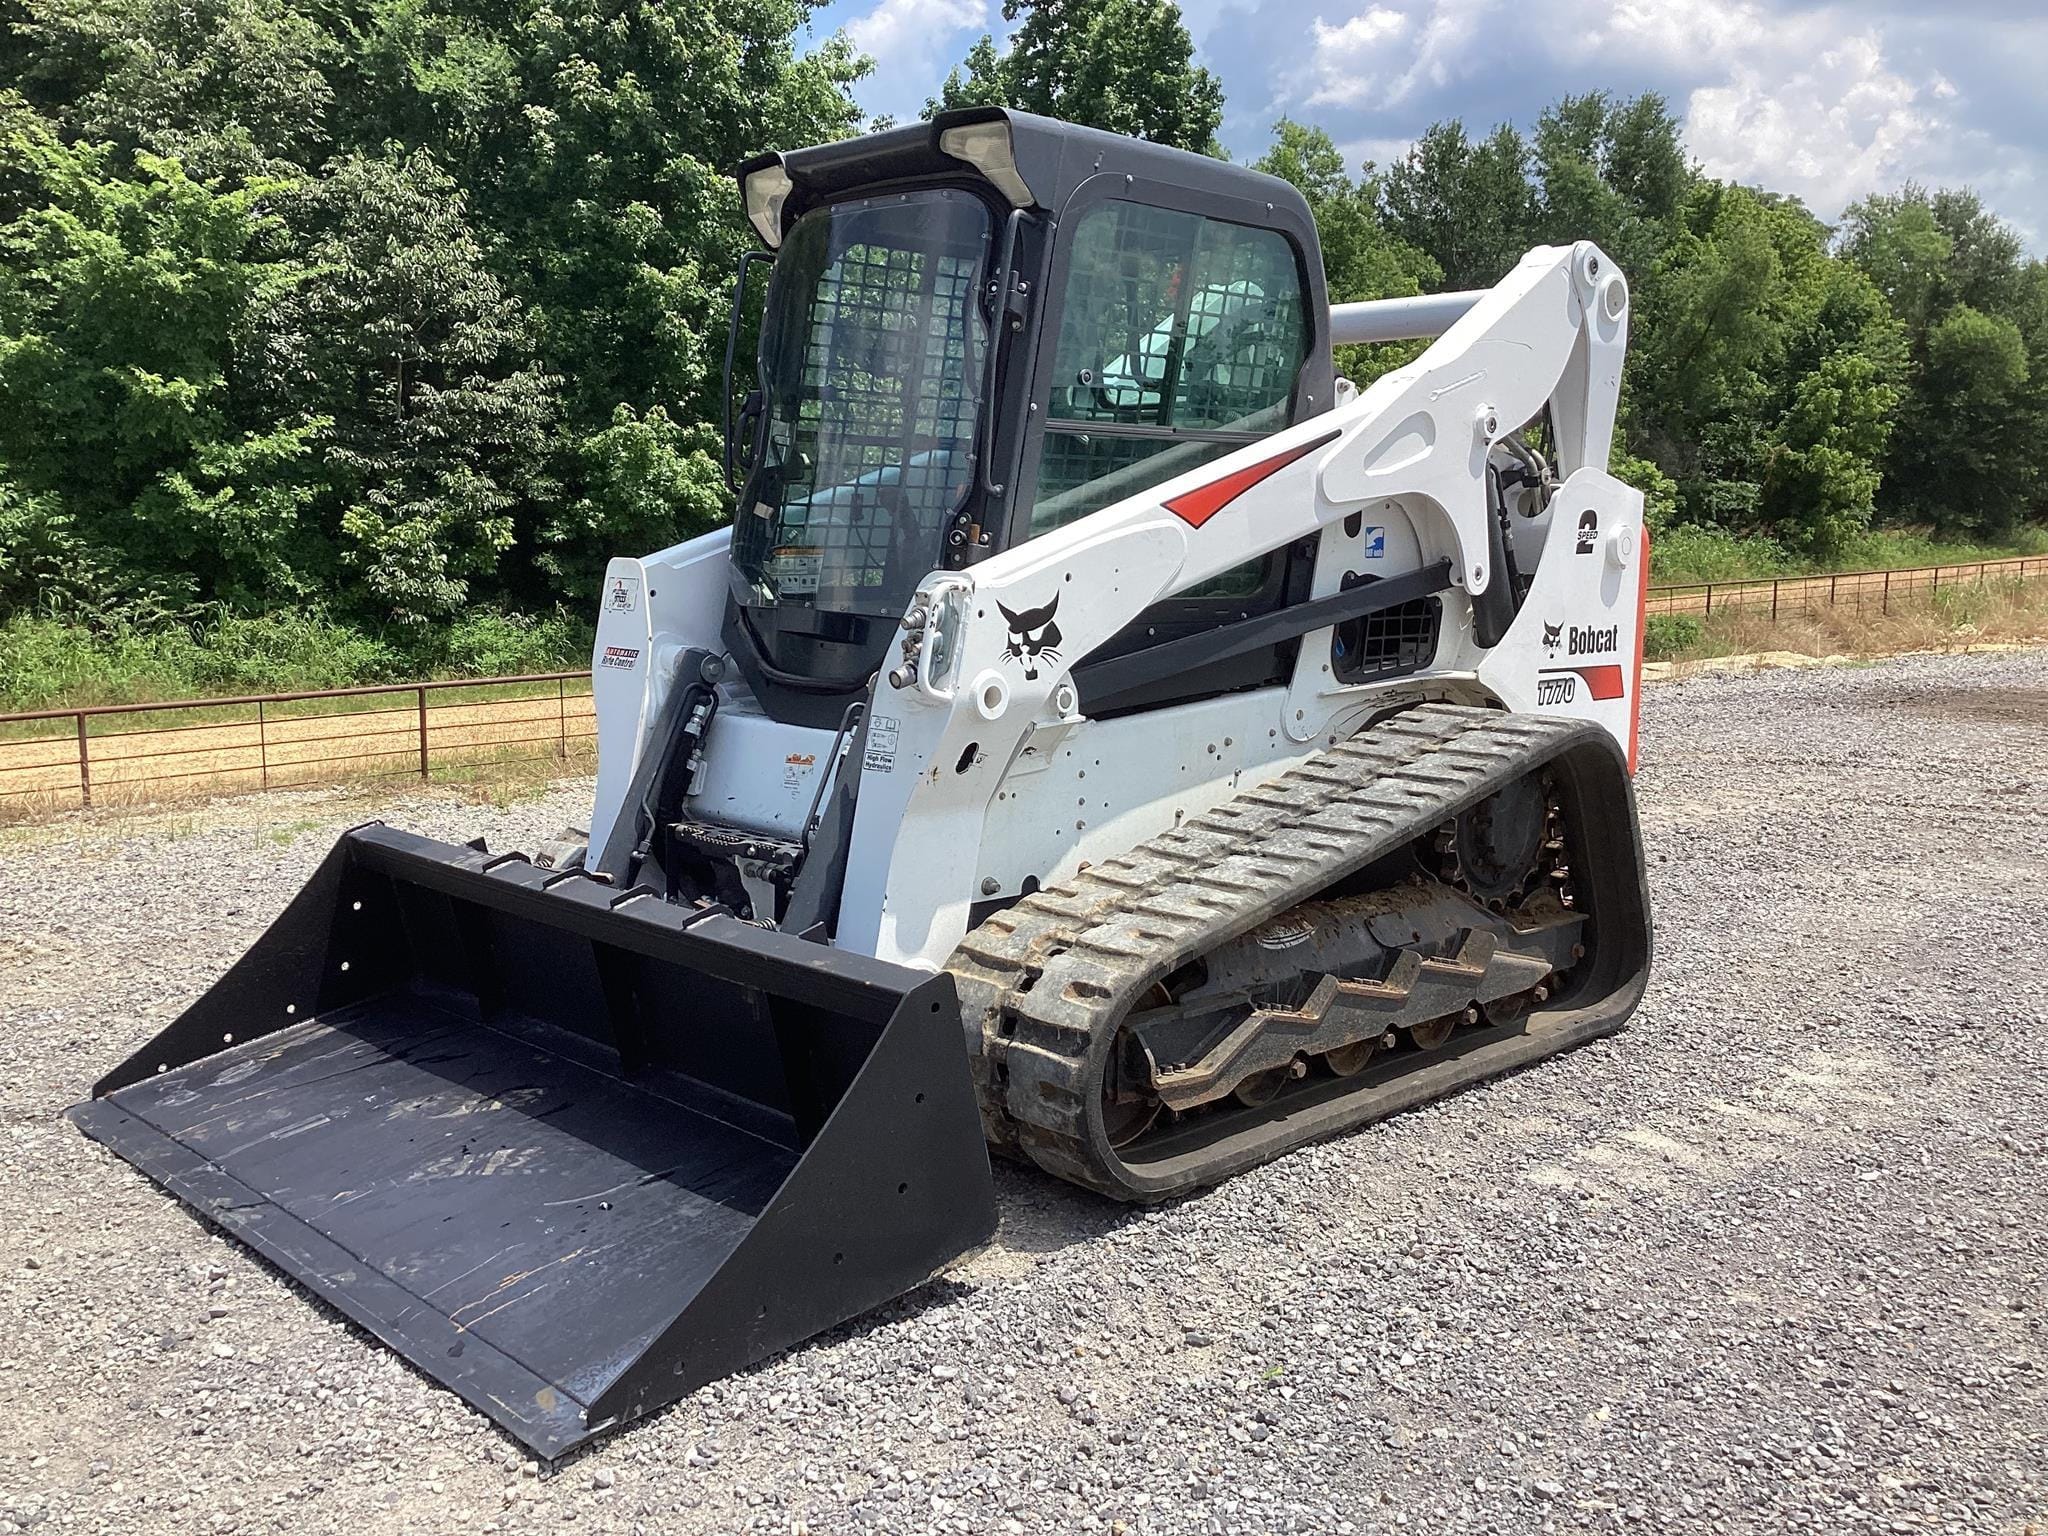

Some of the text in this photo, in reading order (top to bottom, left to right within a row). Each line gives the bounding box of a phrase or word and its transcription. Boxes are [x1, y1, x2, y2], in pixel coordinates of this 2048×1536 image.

[1576, 509, 1597, 554] 2
[1577, 530, 1599, 541] SPEED
[1569, 625, 1617, 655] Bobcat
[606, 647, 639, 658] AUTOMATIC
[613, 657, 636, 668] Control
[1538, 677, 1575, 706] T770
[866, 754, 879, 762] High
